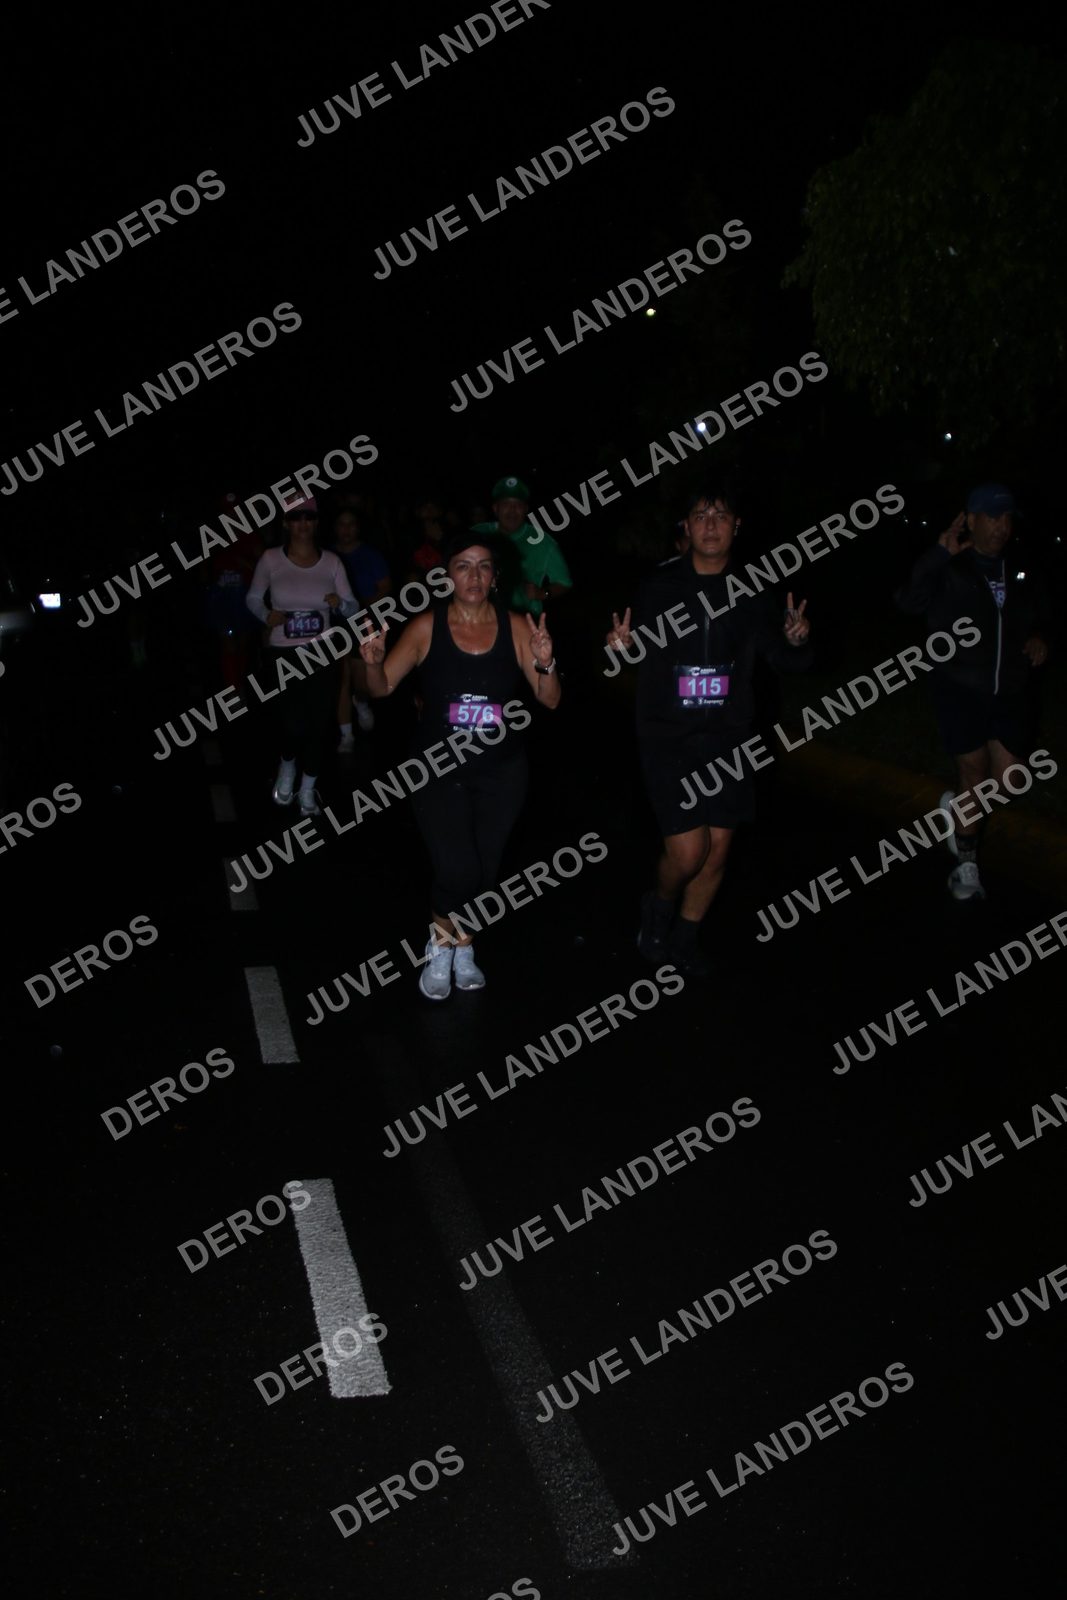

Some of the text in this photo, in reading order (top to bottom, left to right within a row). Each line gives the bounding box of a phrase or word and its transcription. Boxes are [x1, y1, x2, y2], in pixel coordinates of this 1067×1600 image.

[288, 617, 320, 632] 1413
[688, 677, 721, 696] 115
[457, 704, 494, 723] 576
